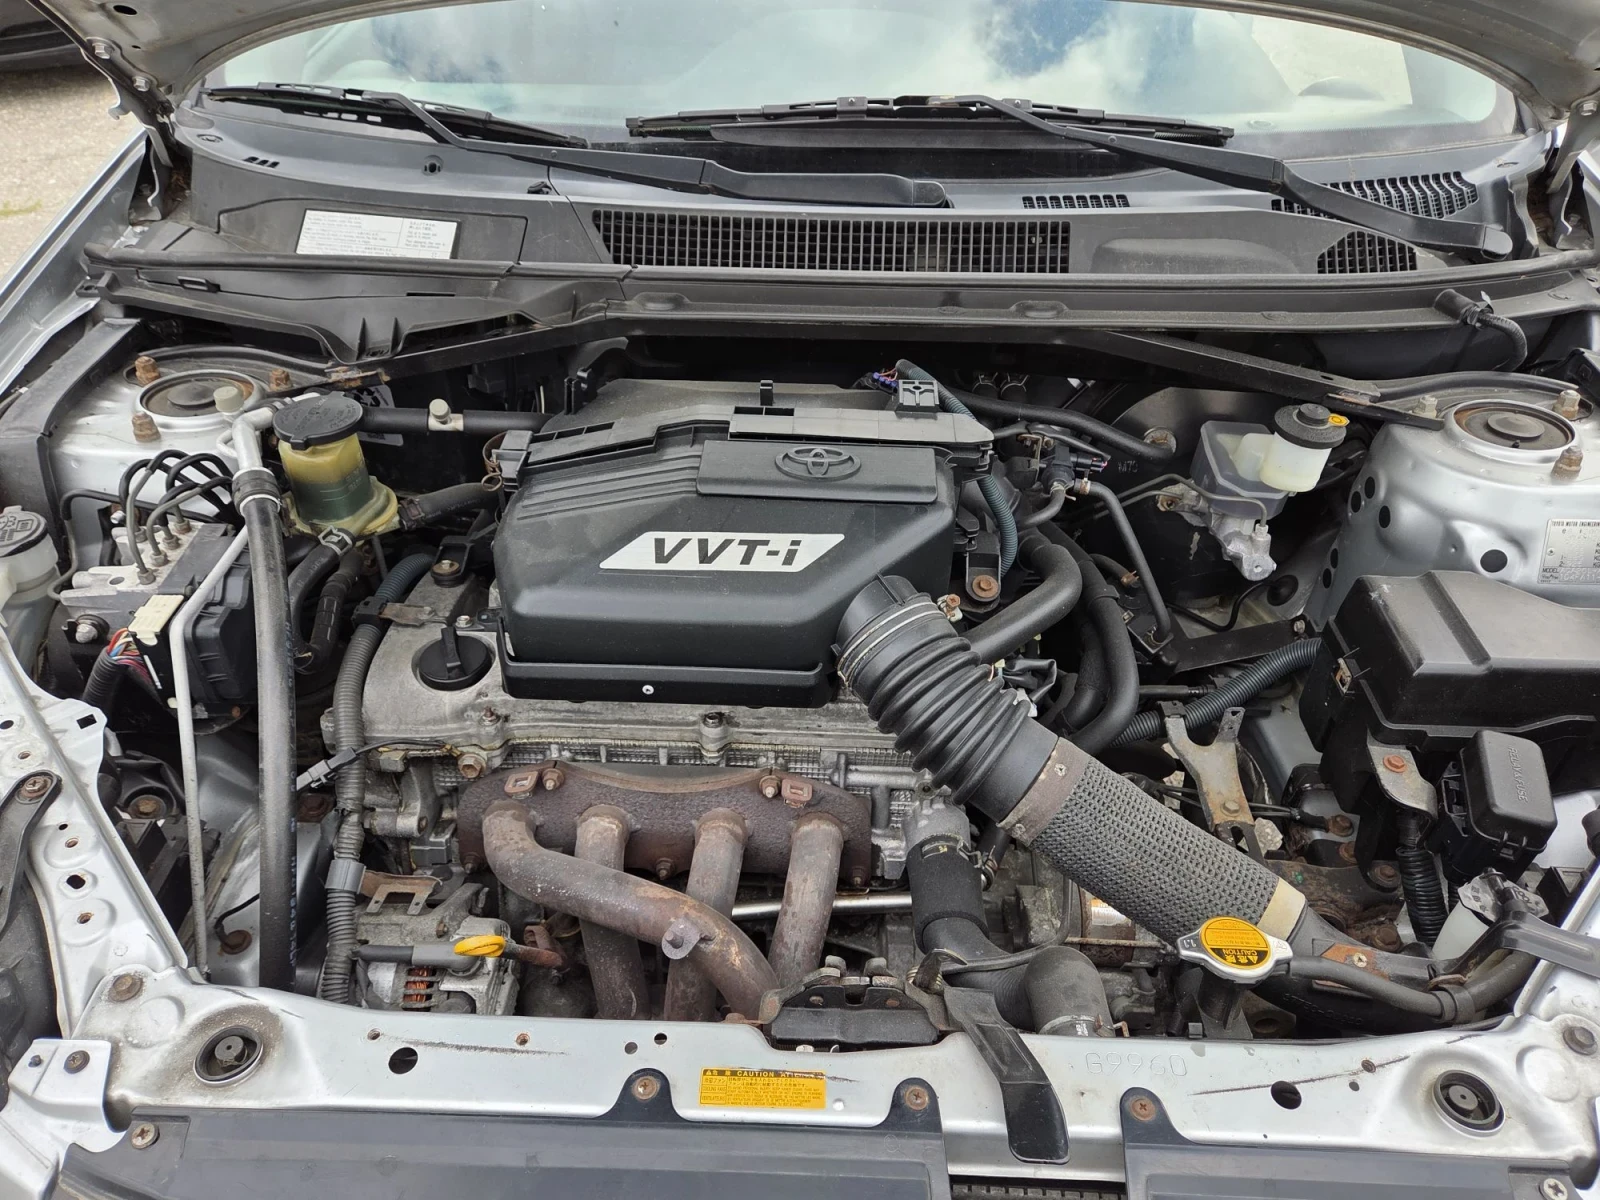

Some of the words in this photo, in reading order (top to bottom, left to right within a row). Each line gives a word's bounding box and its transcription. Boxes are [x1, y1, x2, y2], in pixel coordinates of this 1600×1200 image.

[654, 537, 802, 566] VVT-i
[1222, 949, 1257, 957] CAUTION
[1085, 1052, 1188, 1077] G9960
